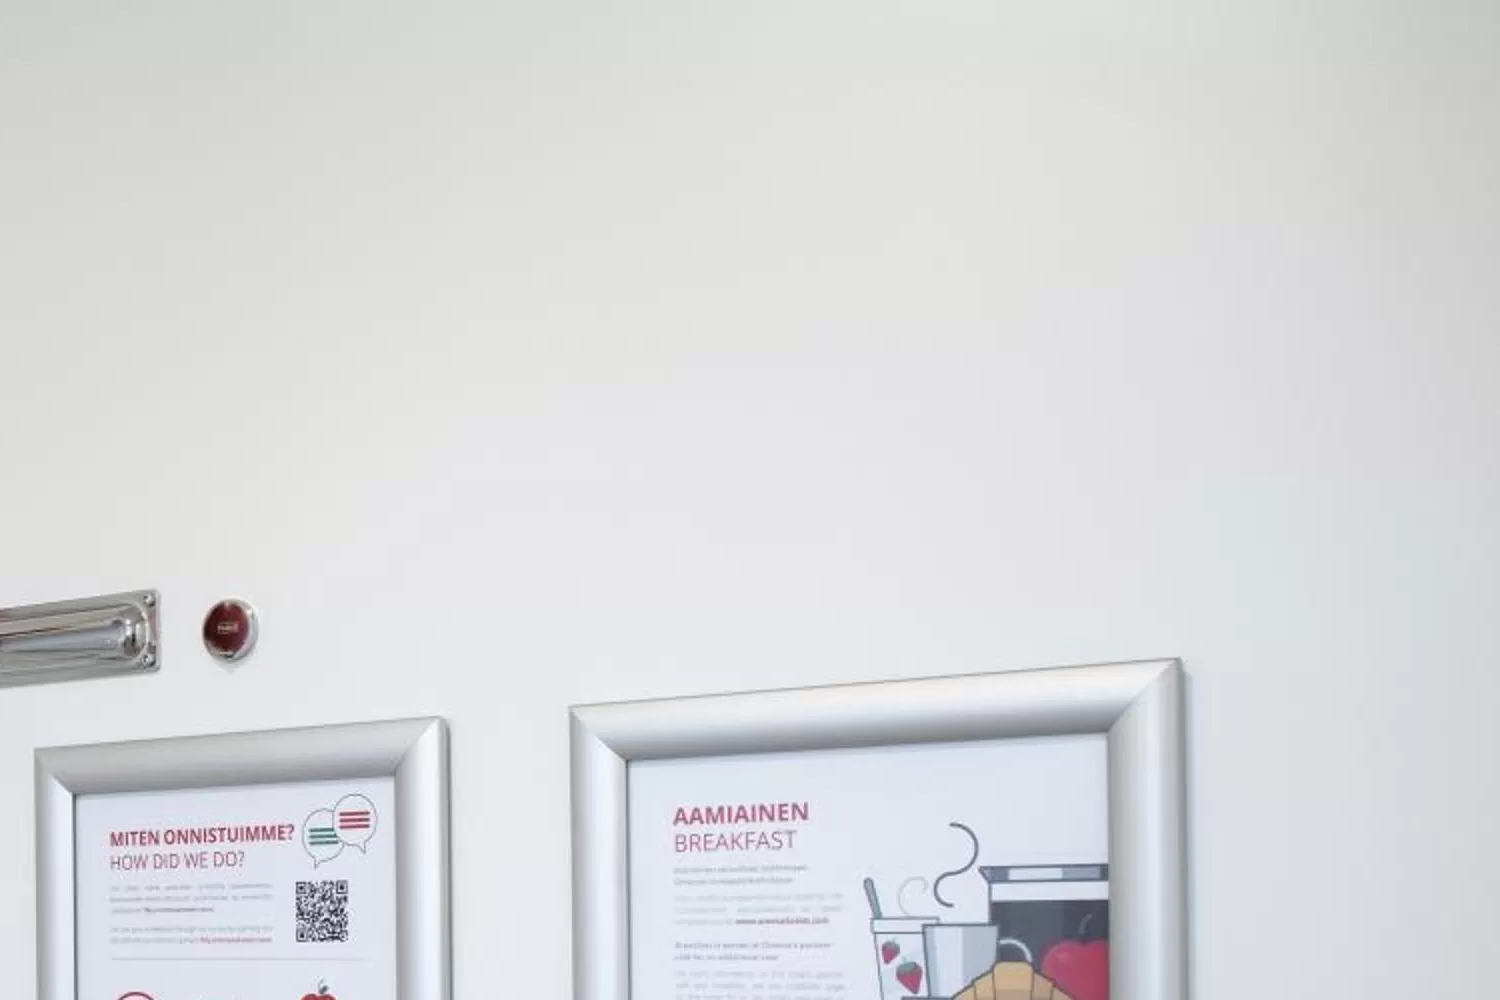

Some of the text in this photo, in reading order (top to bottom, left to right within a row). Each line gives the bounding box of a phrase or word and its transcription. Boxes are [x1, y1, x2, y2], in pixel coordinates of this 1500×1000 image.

[673, 802, 808, 826] AAMIAINEN
[110, 824, 294, 846] MITEN ONNISTUIMME?
[675, 830, 796, 852] BREAKFAST
[110, 851, 244, 870] HOW DID WE DO?
